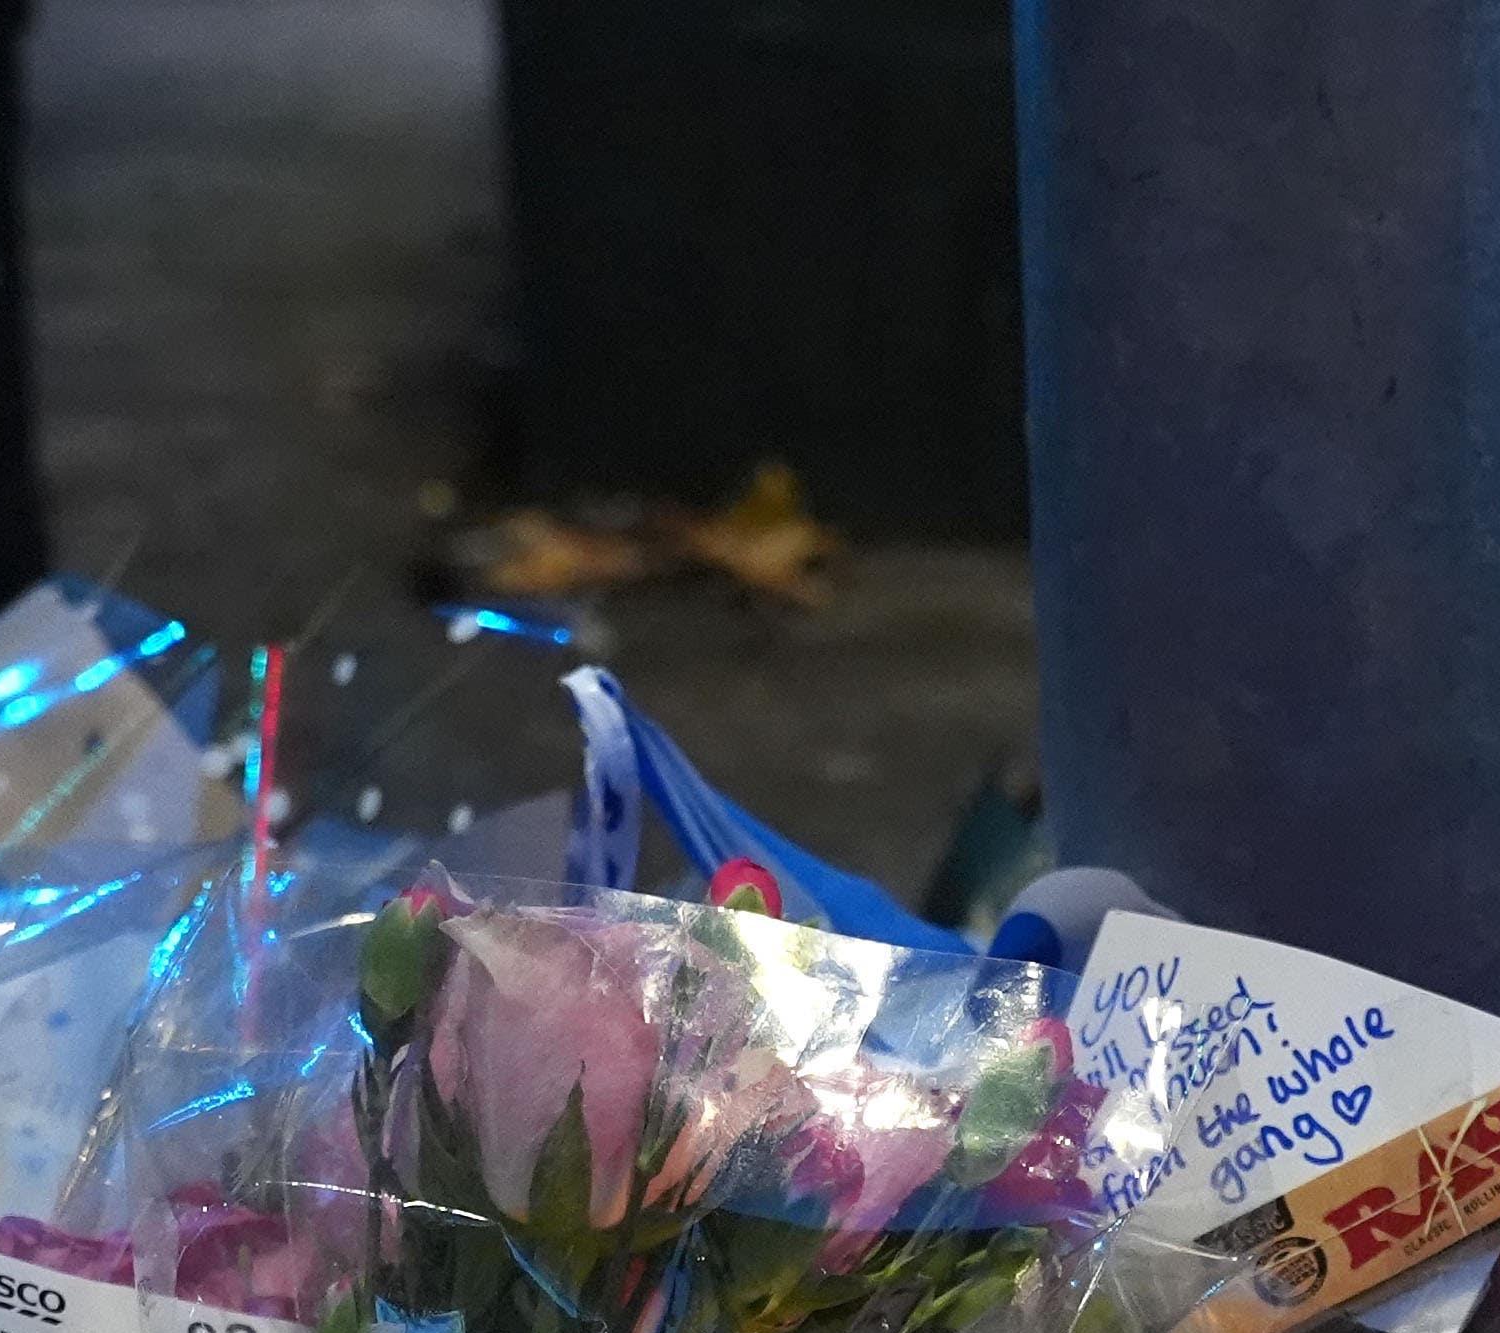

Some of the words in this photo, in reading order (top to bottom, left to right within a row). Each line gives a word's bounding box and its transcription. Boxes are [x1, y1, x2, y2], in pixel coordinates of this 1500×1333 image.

[1197, 1092, 1262, 1149] the
[1267, 1007, 1395, 1105] whole
[1211, 1112, 1344, 1204] gang
